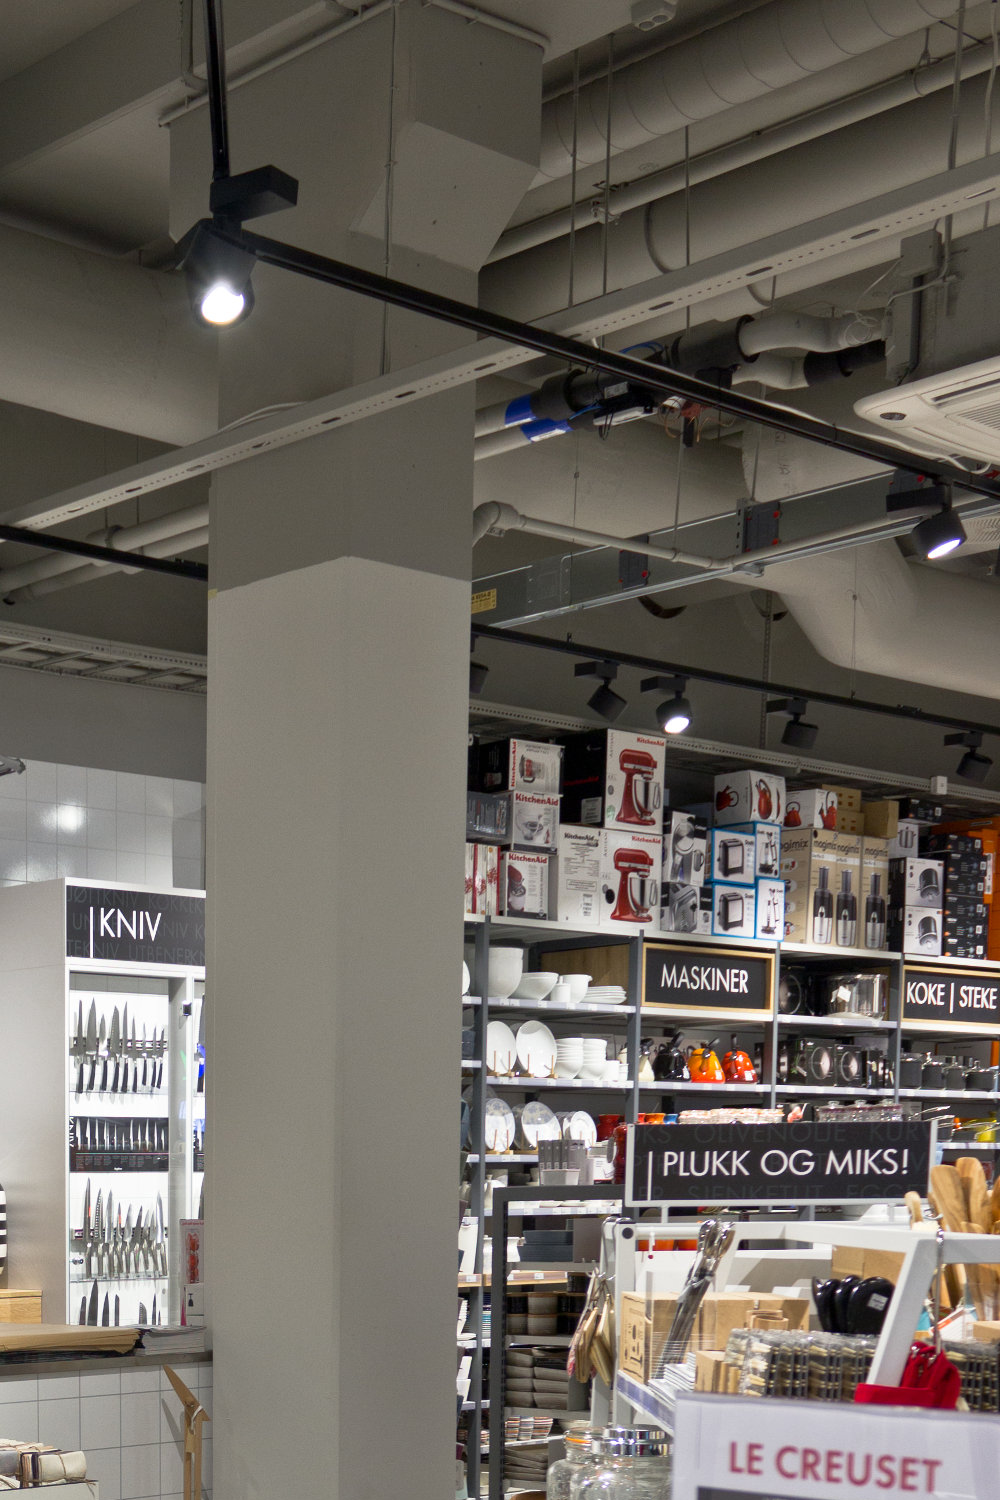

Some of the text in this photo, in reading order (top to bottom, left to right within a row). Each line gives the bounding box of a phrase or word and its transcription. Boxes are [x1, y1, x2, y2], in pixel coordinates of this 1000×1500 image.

[637, 737, 665, 747] KitchenAid
[515, 792, 559, 807] KitchenAid
[564, 832, 595, 842] KitchenAid
[631, 835, 662, 845] KitchenAid
[508, 853, 548, 864] KitchenAid
[100, 907, 162, 941] KNIV
[661, 963, 749, 994] MASKINER
[906, 982, 997, 1010] KOKE STEKE
[662, 1148, 909, 1177] PLUKK OG MIKS!
[728, 1441, 943, 1494] LE CREUSET
